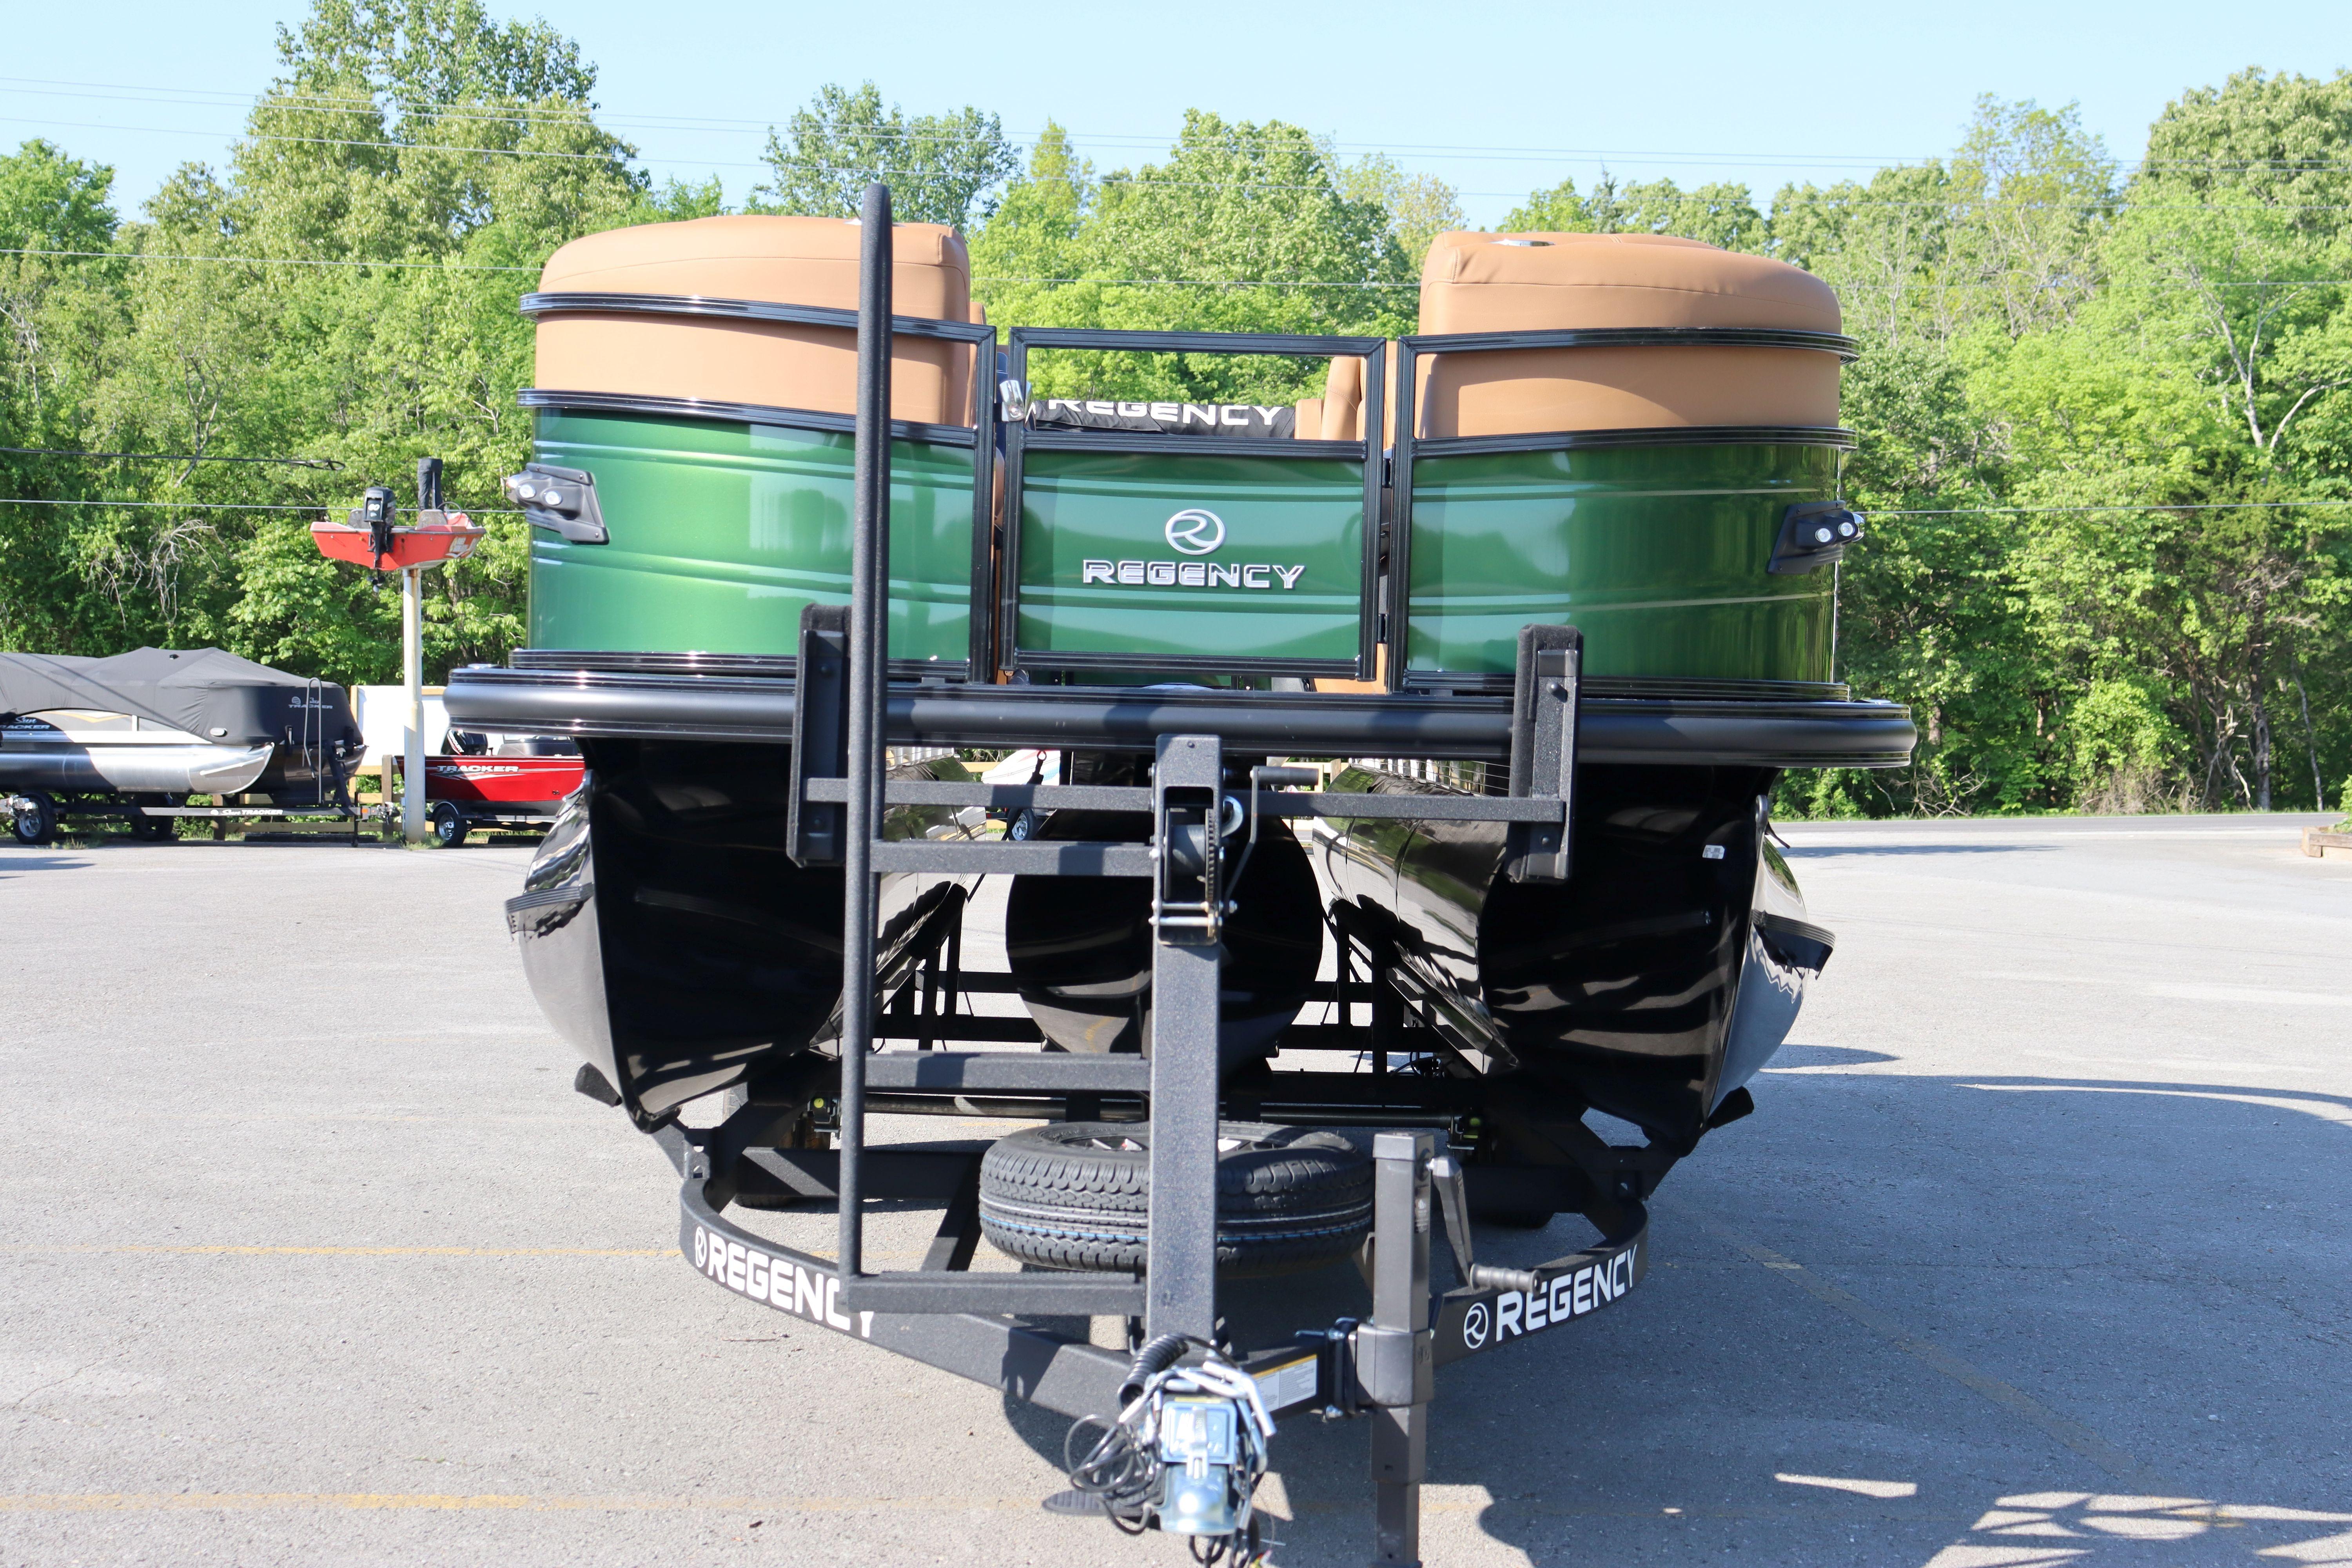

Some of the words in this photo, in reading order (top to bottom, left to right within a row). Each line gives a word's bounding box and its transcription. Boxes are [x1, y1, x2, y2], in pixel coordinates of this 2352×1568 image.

[1048, 399, 1285, 426] REGENCY
[1083, 559, 1305, 589] REGENCY
[1495, 1243, 1638, 1342] REGENCY
